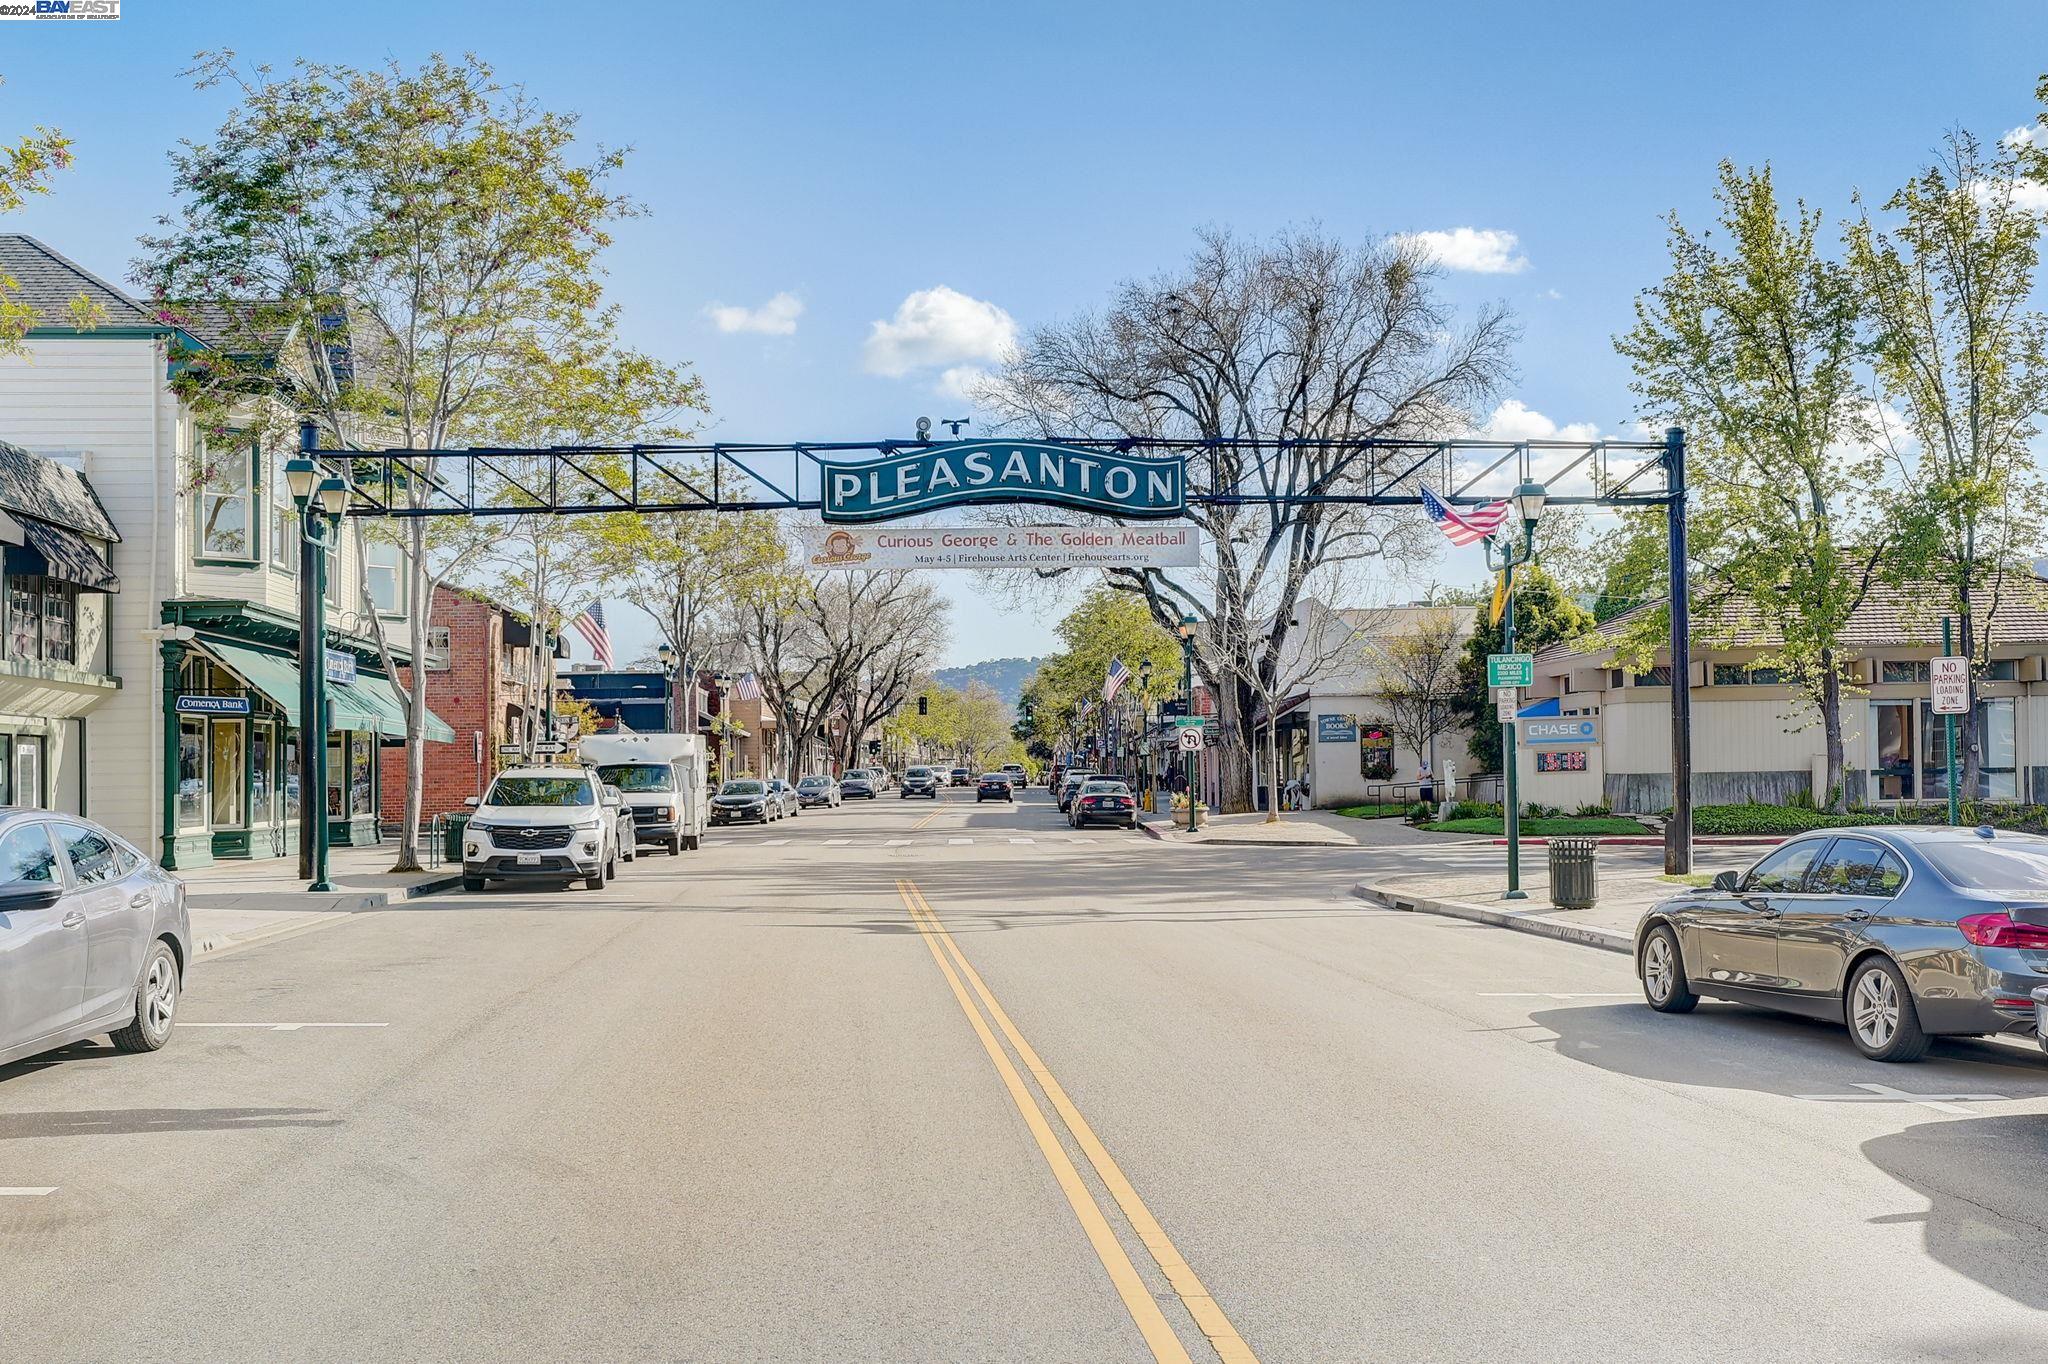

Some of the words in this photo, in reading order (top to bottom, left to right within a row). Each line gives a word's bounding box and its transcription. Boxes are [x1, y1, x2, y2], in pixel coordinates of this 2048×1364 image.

[834, 451, 1173, 507] PLEASANTON
[877, 535, 934, 548] Curious
[941, 534, 998, 549] George
[1006, 533, 1017, 546] &
[1026, 532, 1052, 546] The
[1061, 532, 1113, 546] Golden
[1122, 531, 1186, 546] Meatball
[914, 555, 935, 563] May
[958, 554, 1006, 562] Firehouse
[1007, 554, 1027, 562] Arts
[1029, 553, 1060, 562] Center
[1068, 553, 1149, 563] firehousearts.org
[1941, 662, 1957, 673] NO
[1933, 674, 1966, 684] PARKING
[1936, 685, 1964, 694] LOADING
[222, 700, 243, 709] Bank
[1941, 696, 1959, 705] ZONE
[1528, 724, 1578, 736] CHASE
